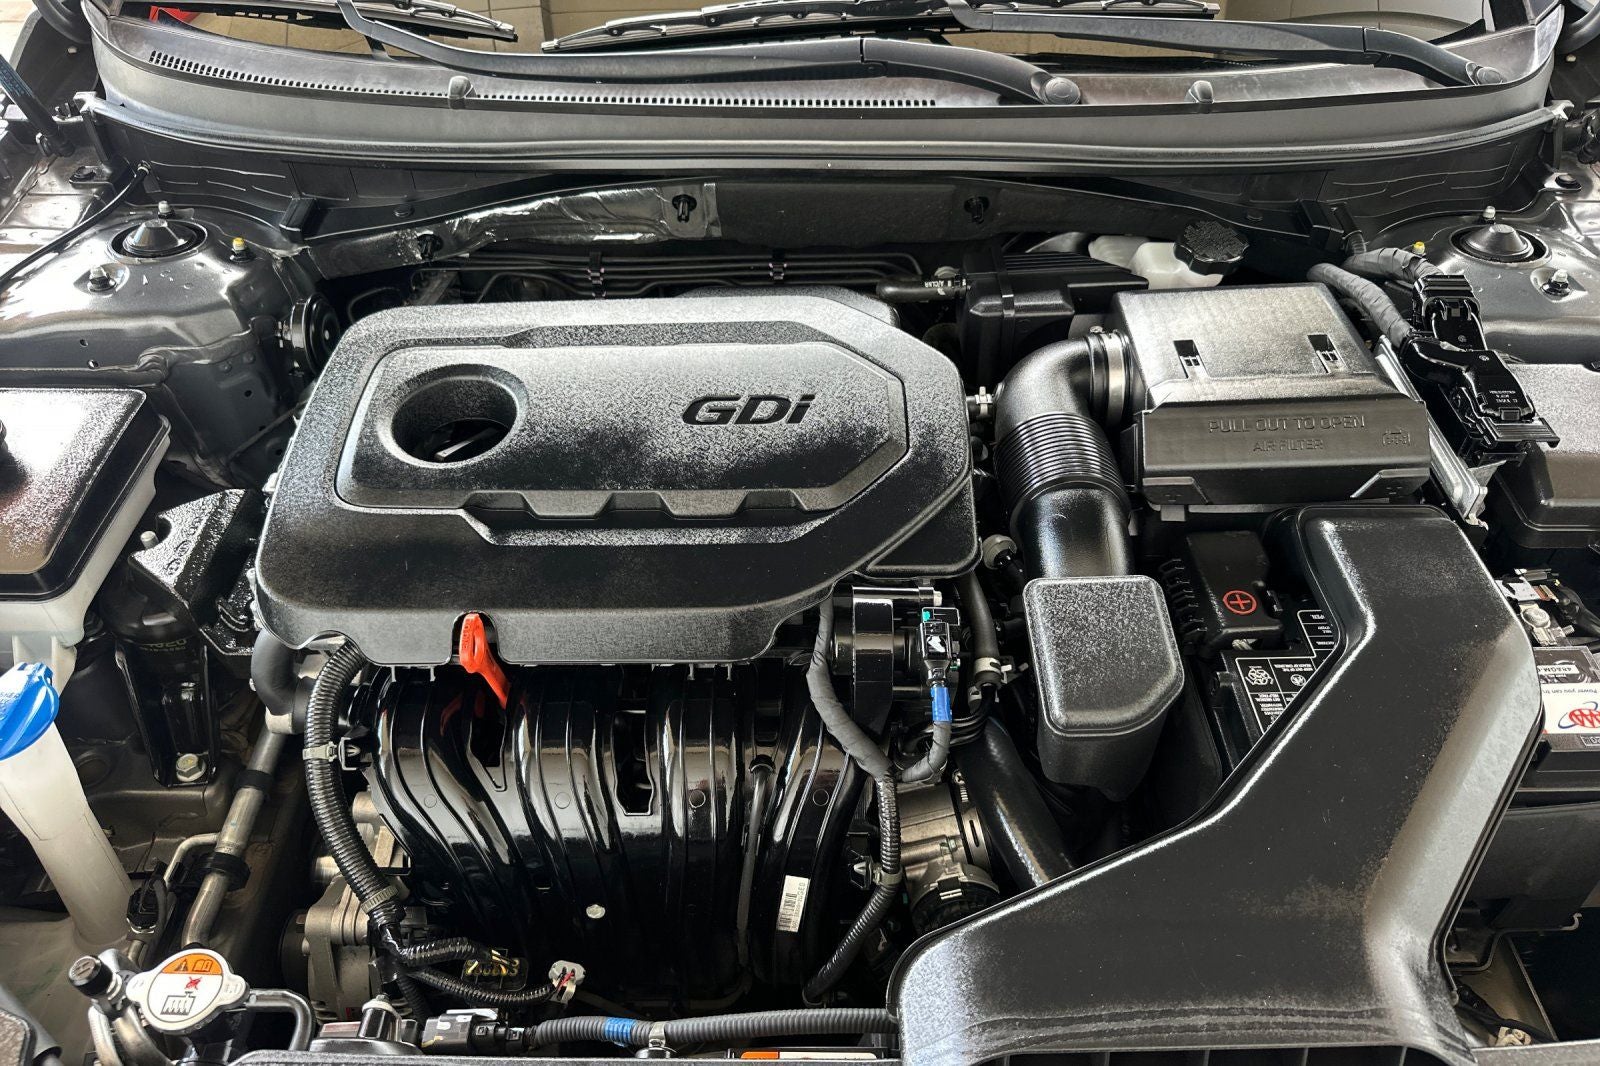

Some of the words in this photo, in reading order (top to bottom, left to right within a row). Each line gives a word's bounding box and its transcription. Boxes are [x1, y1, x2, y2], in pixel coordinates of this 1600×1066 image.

[682, 394, 815, 425] GDi
[1208, 418, 1250, 433] PULL
[1255, 417, 1288, 432] OUT
[1295, 416, 1315, 430] TO
[1320, 415, 1365, 430] OPEN
[1253, 439, 1275, 452] AIR
[1279, 438, 1324, 451] FILTER
